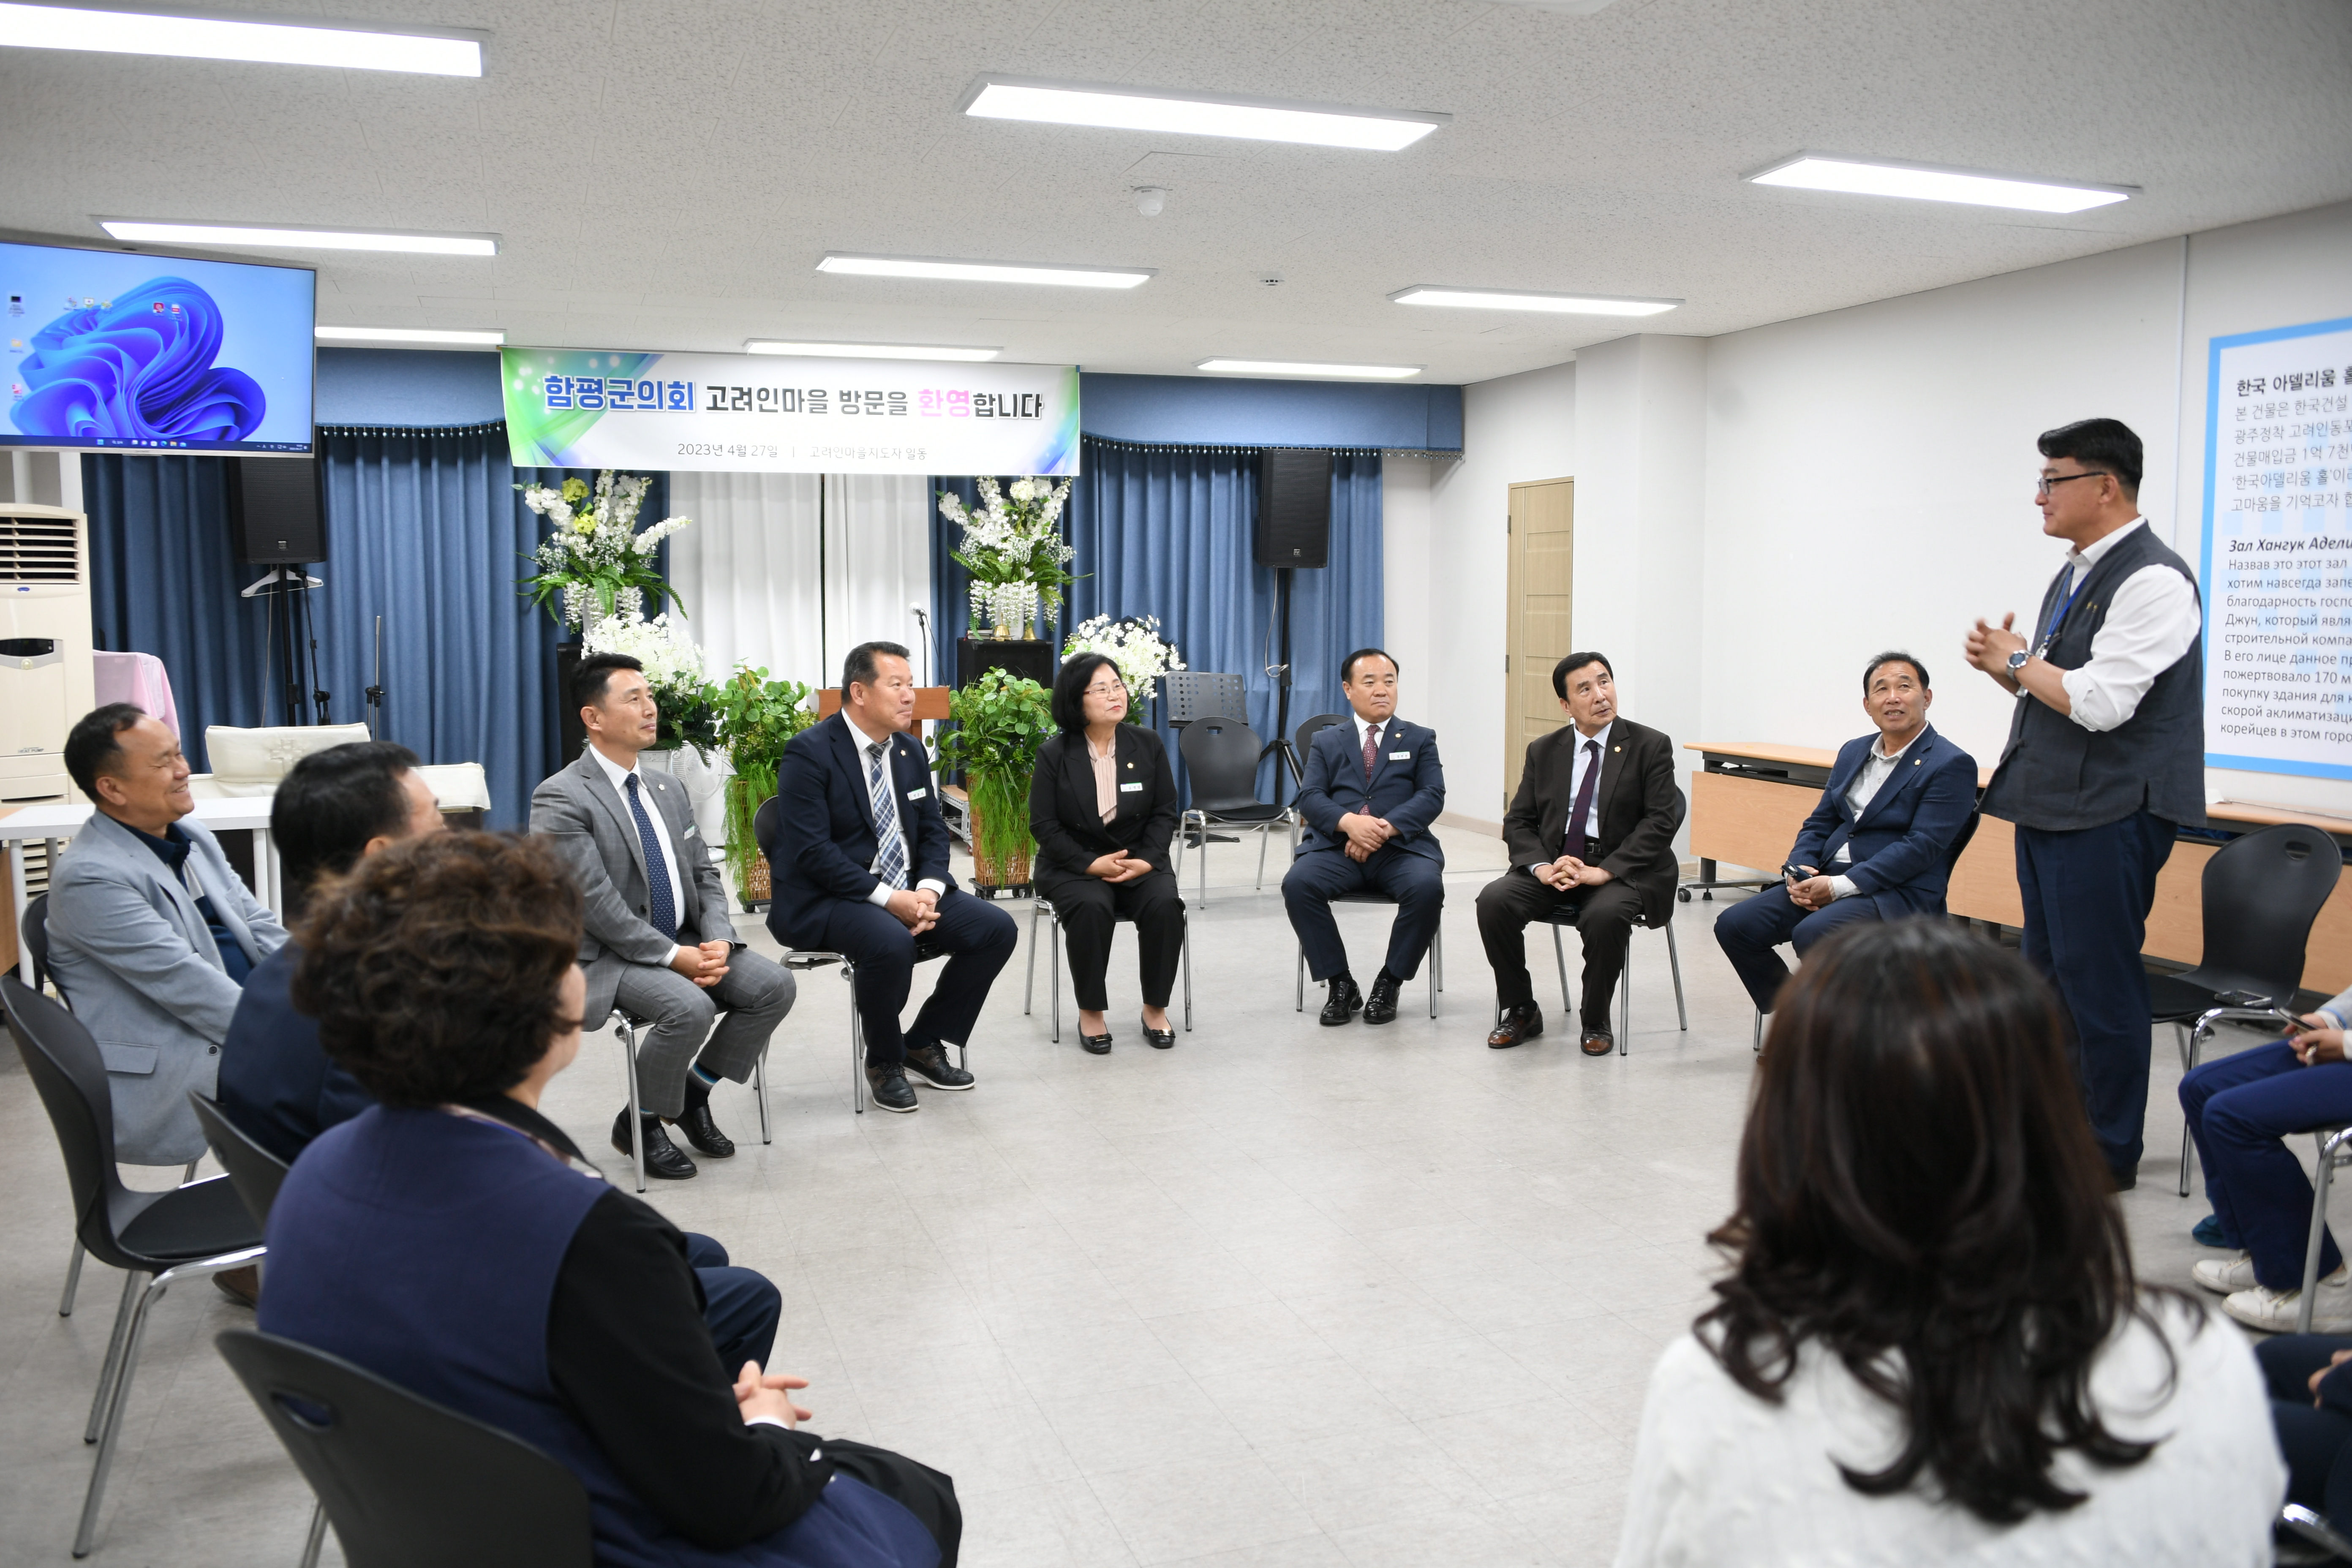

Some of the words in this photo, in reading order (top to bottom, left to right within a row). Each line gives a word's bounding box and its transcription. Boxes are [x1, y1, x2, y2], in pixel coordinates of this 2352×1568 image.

[2237, 377, 2266, 397] 한국
[2273, 369, 2335, 392] 아델리움
[544, 375, 696, 412] 함평군의회
[706, 385, 828, 414] 고려인마을
[838, 389, 908, 416] 방문을
[917, 389, 1044, 419] 환영합니다
[2235, 406, 2247, 421] 본
[2252, 402, 2289, 419] 건물은
[2295, 395, 2347, 415] 한국건설
[2235, 426, 2284, 444] 광주정착
[678, 443, 723, 456] 2023년
[727, 444, 746, 457] 4월
[751, 445, 778, 457] 27일
[810, 446, 901, 459] 고려인마을지도자
[906, 447, 927, 460] 일동
[2234, 447, 2296, 467] 건물매입금
[2302, 446, 2321, 460] 1억
[2328, 444, 2352, 460] 7천
[2231, 496, 2281, 512] 고마움을
[2287, 493, 2338, 509] 기억코자
[2229, 540, 2253, 552] Зал
[2257, 539, 2304, 553] Хангук
[2229, 559, 2269, 570] Назвав
[2273, 561, 2292, 569] это
[2296, 560, 2322, 569] этот
[2326, 559, 2347, 569] зал
[2227, 579, 2262, 588] хотим
[2267, 578, 2321, 590] навсегда
[2227, 595, 2316, 609] благодарность
[2225, 614, 2261, 627] Джун,
[2265, 614, 2317, 628] который
[2322, 615, 2352, 626] явля
[2225, 633, 2308, 645] строительной
[2225, 650, 2231, 661] В
[2235, 652, 2253, 662] его
[2257, 653, 2286, 664] лице
[2289, 654, 2336, 664] данное
[2224, 670, 2310, 682] пожертвовало
[2315, 672, 2337, 683] 170
[2341, 675, 2352, 684] м
[2223, 688, 2269, 700] покупку
[2273, 690, 2317, 702] здания
[2320, 692, 2344, 703] для
[2221, 705, 2262, 718] скорой
[2221, 724, 2276, 737] корейцев
[2281, 728, 2286, 737] в
[2291, 729, 2320, 740] этом
